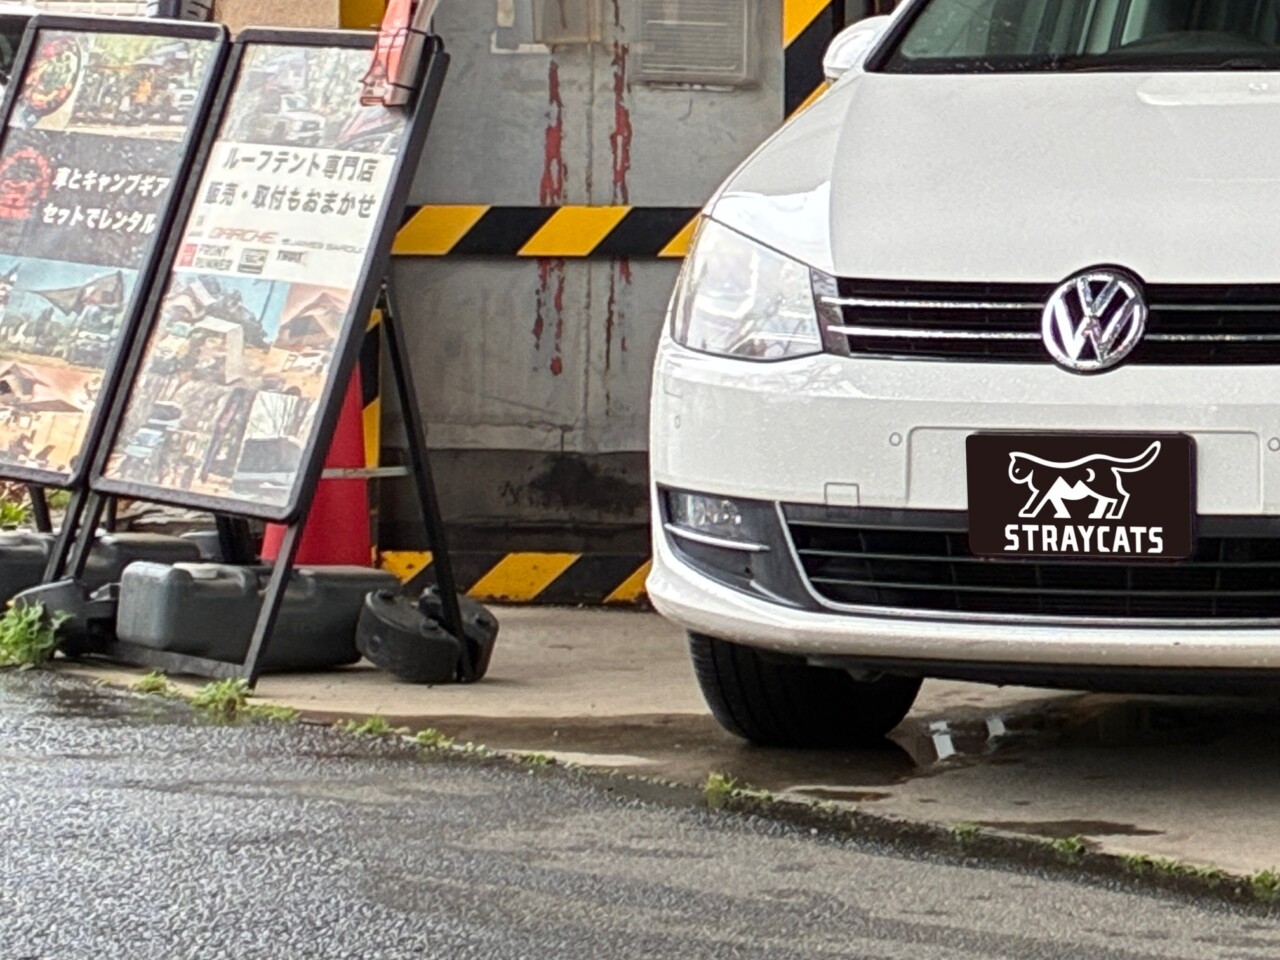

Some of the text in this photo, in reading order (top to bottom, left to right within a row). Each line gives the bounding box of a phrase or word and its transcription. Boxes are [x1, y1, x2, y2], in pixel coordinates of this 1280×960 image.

[223, 147, 379, 183] ルーフテント専門店
[203, 180, 377, 219] 販売・取付もおまかせ
[42, 202, 158, 235] セットでレンタル
